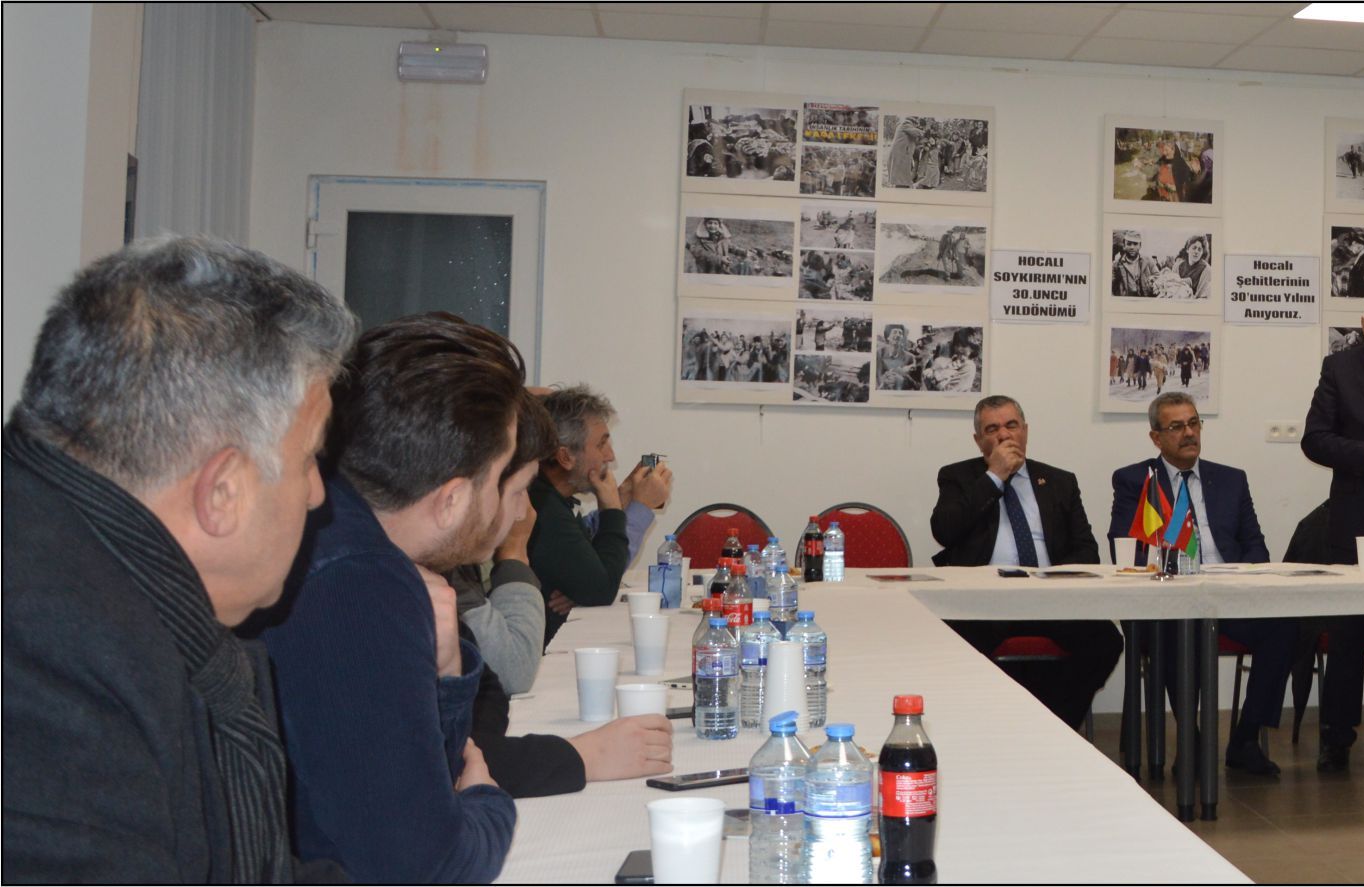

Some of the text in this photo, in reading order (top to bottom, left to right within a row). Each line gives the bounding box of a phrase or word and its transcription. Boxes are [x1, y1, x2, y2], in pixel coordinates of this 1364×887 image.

[1018, 256, 1064, 267] HOCALI
[1253, 260, 1294, 271] Hocalı
[993, 271, 1087, 285] SOYKIRIMI'NIN
[1236, 275, 1310, 289] Şehitlerinin
[1012, 289, 1068, 301] 30.UNCU
[1230, 291, 1316, 303] 30'uncu Yılını
[1003, 303, 1077, 317] YILDÖNÜMÜ
[1244, 308, 1302, 321] Anıyoruz.
